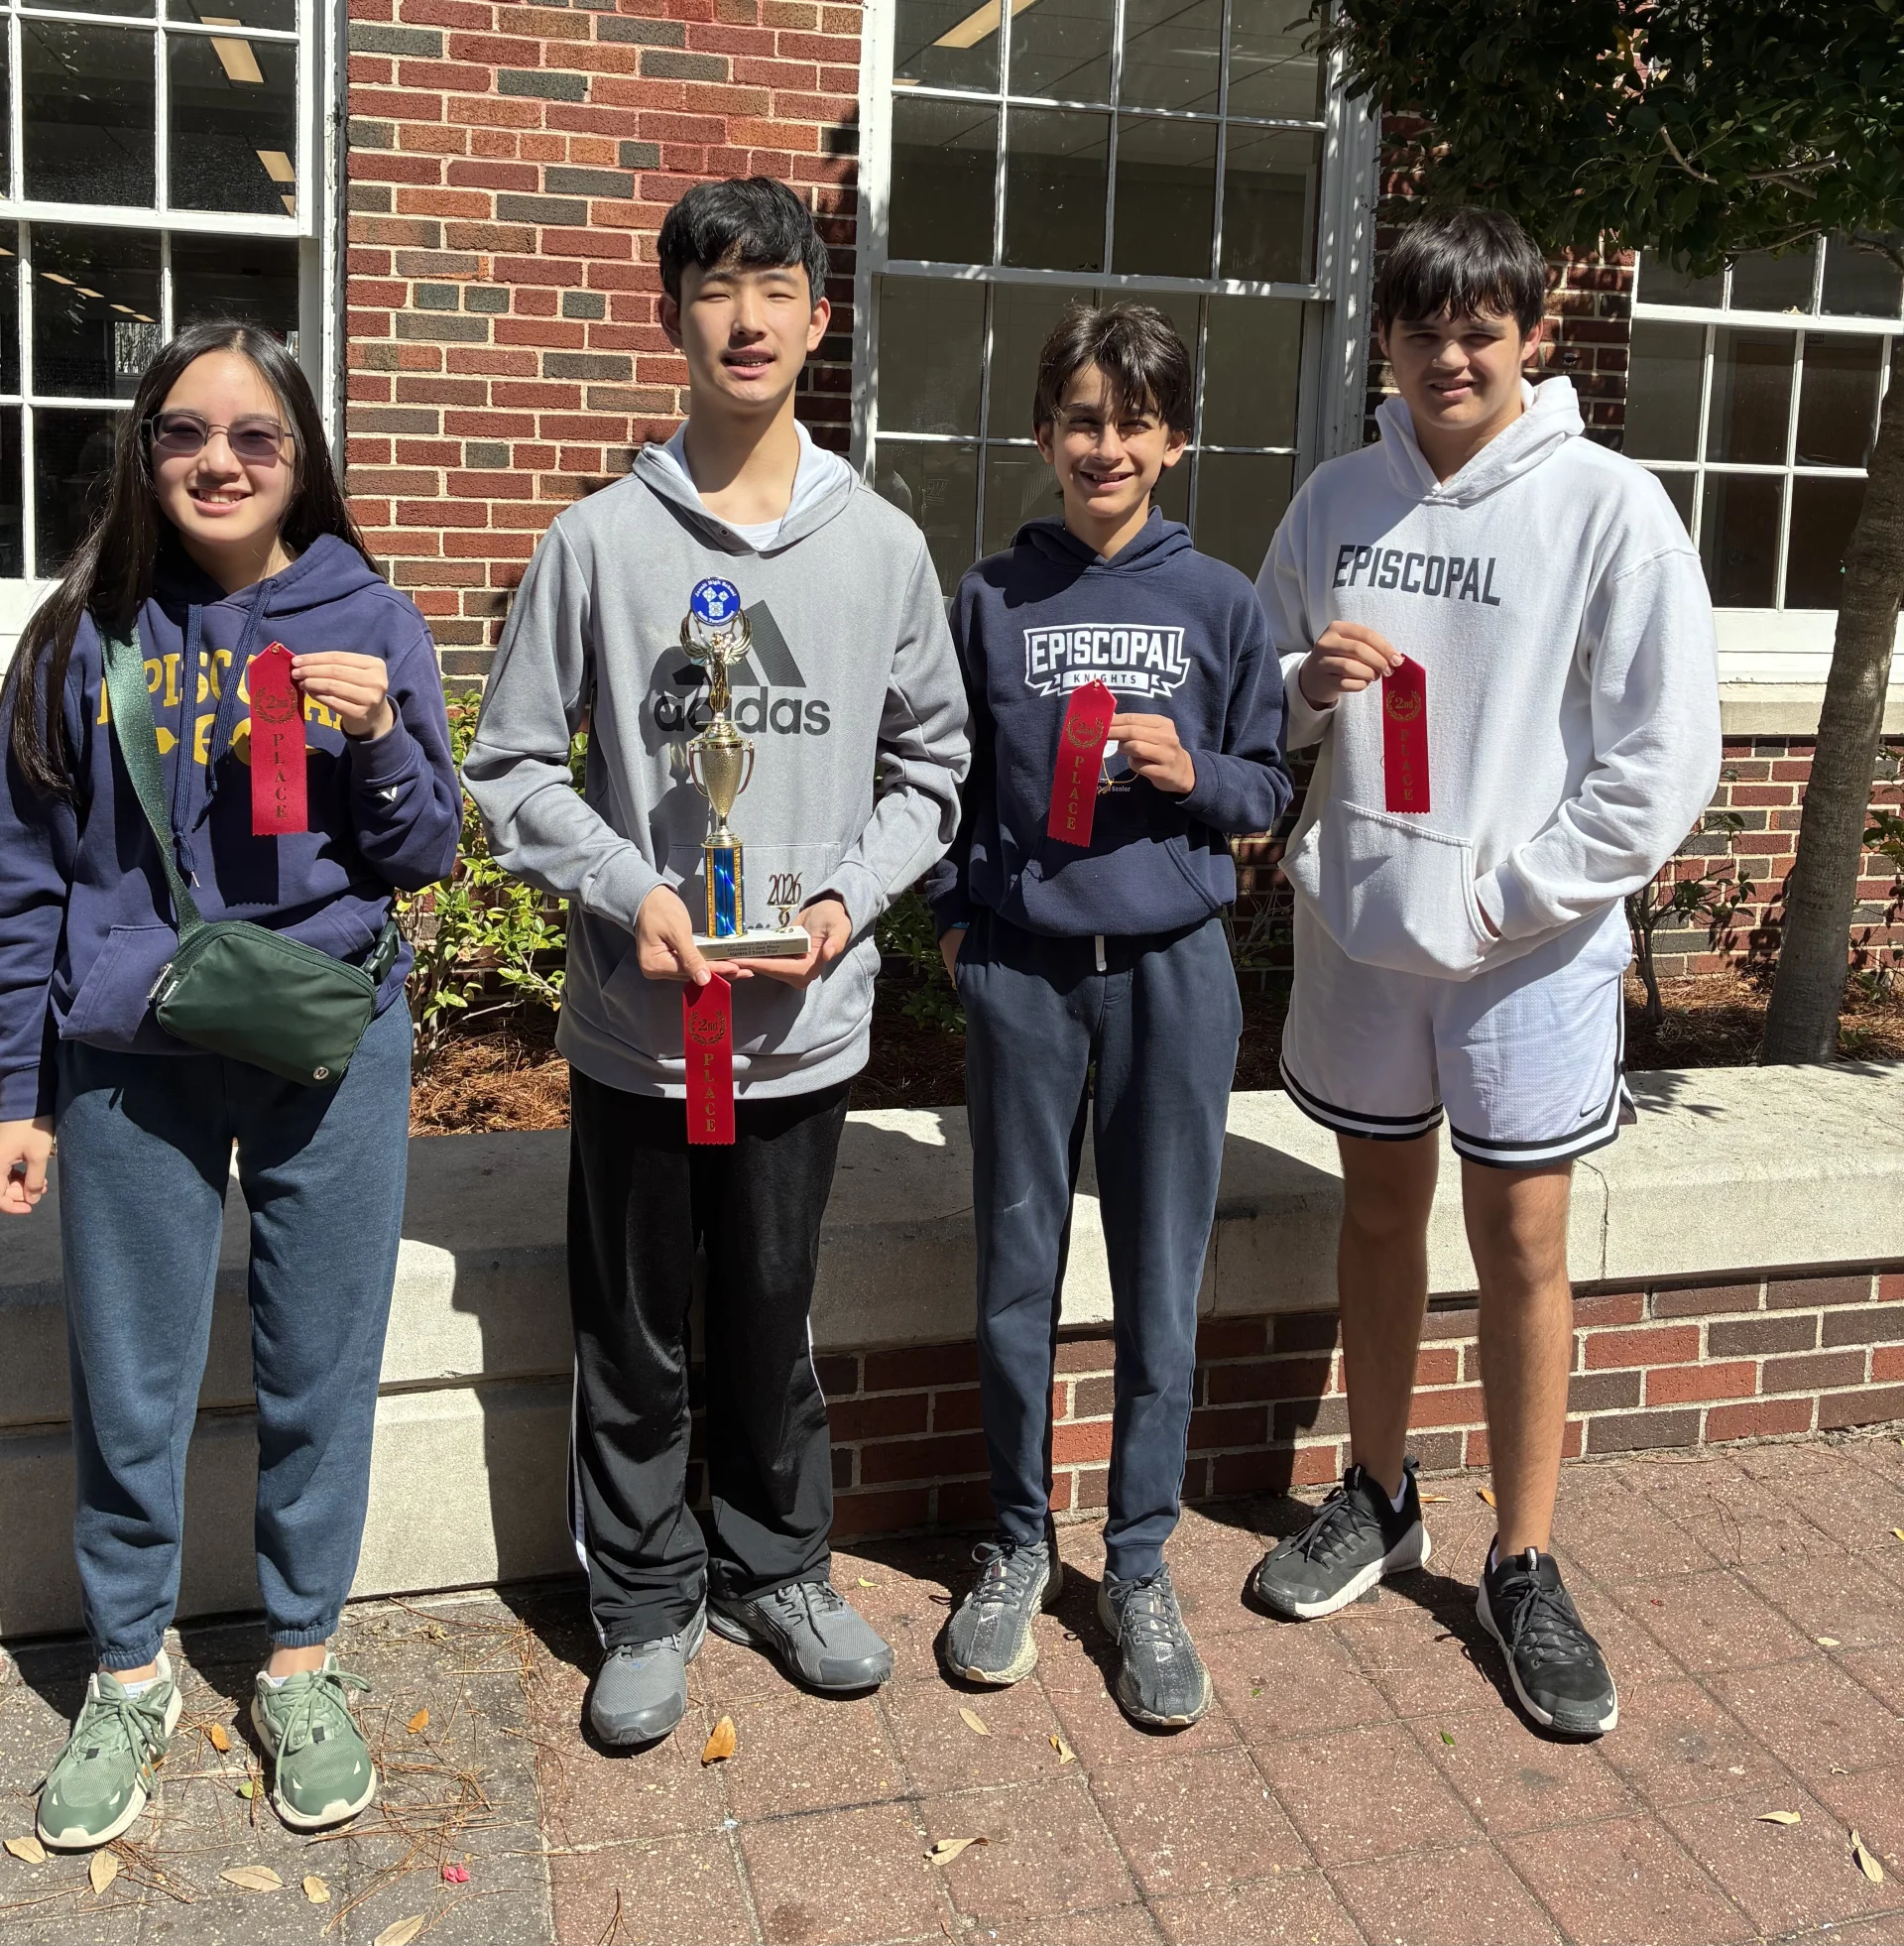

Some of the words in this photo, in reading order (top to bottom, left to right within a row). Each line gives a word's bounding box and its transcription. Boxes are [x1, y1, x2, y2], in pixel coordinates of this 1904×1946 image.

[1332, 544, 1501, 607] EPISCOPAL
[1031, 629, 1183, 675] EPISCOPAL
[1073, 672, 1137, 684] KNIGHTS
[1395, 696, 1413, 709] 2nd
[273, 733, 288, 818] PLACE
[1399, 728, 1414, 801] PLACE
[1066, 755, 1085, 830] PLACE
[767, 872, 802, 905] 2026
[698, 1018, 718, 1032] 2nd
[703, 1052, 716, 1133] PLACE
